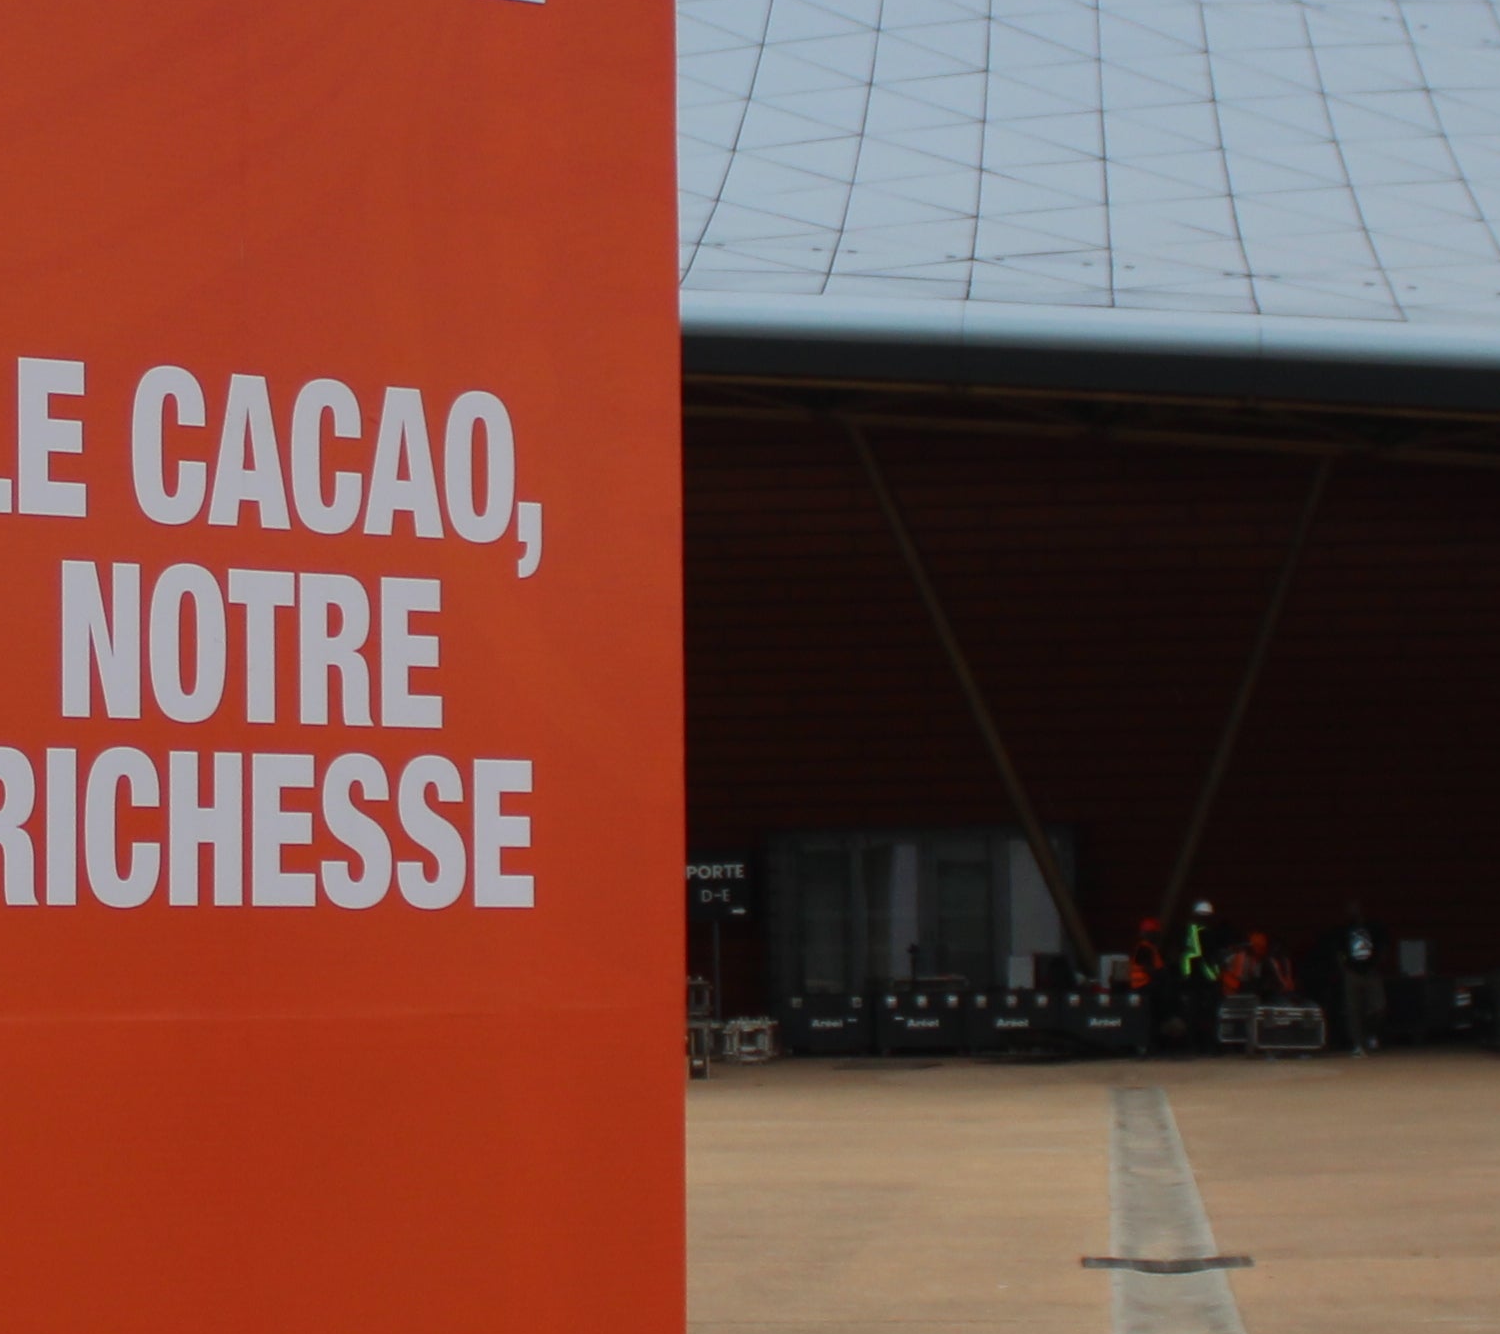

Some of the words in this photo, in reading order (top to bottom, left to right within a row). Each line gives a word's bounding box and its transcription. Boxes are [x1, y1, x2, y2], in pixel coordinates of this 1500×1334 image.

[131, 364, 543, 579] CACAO,
[61, 559, 444, 729] NOTRE
[686, 863, 745, 880] PORTE
[701, 889, 731, 903] D-E
